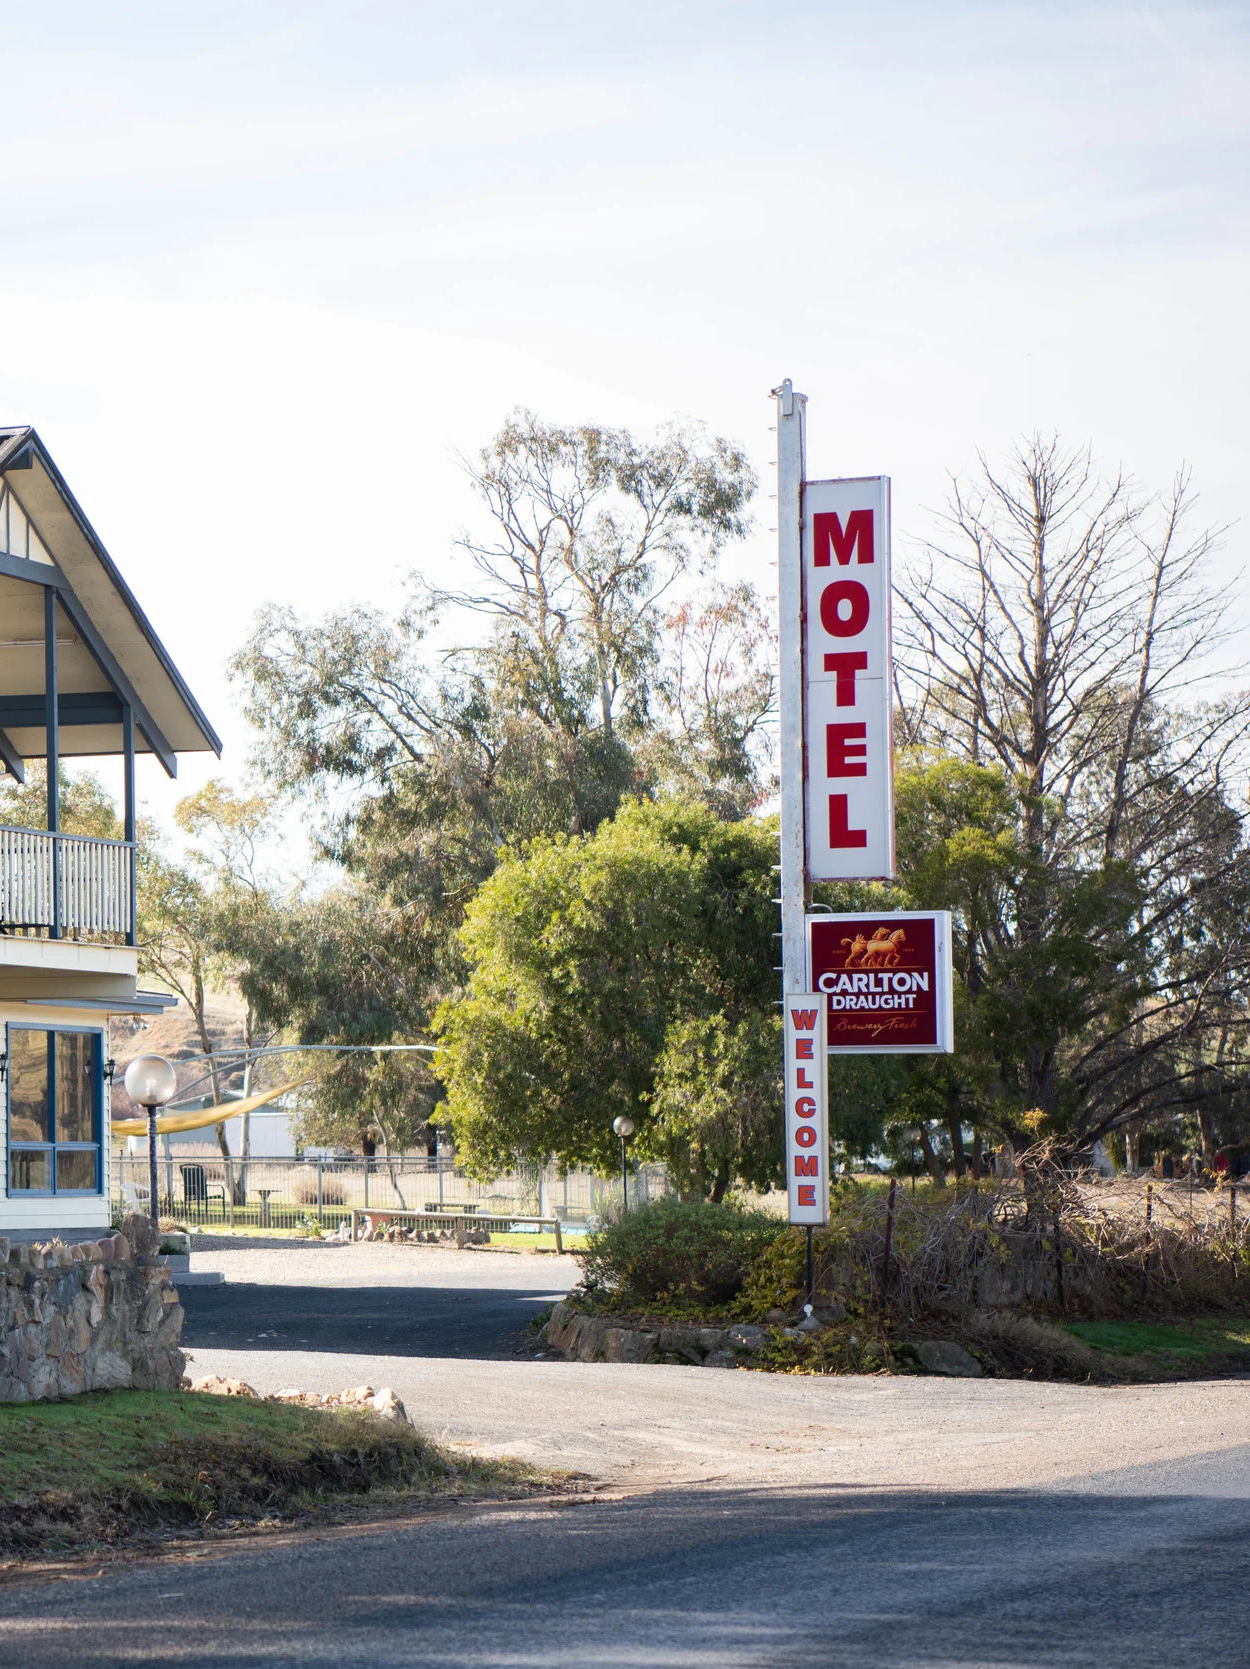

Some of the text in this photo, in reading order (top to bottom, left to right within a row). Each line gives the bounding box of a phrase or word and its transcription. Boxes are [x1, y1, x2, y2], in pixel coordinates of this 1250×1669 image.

[813, 508, 875, 849] MOTEL
[818, 972, 929, 993] CARLTON
[832, 994, 917, 1010] DRAUGHT
[790, 1008, 819, 1207] WELCOME
